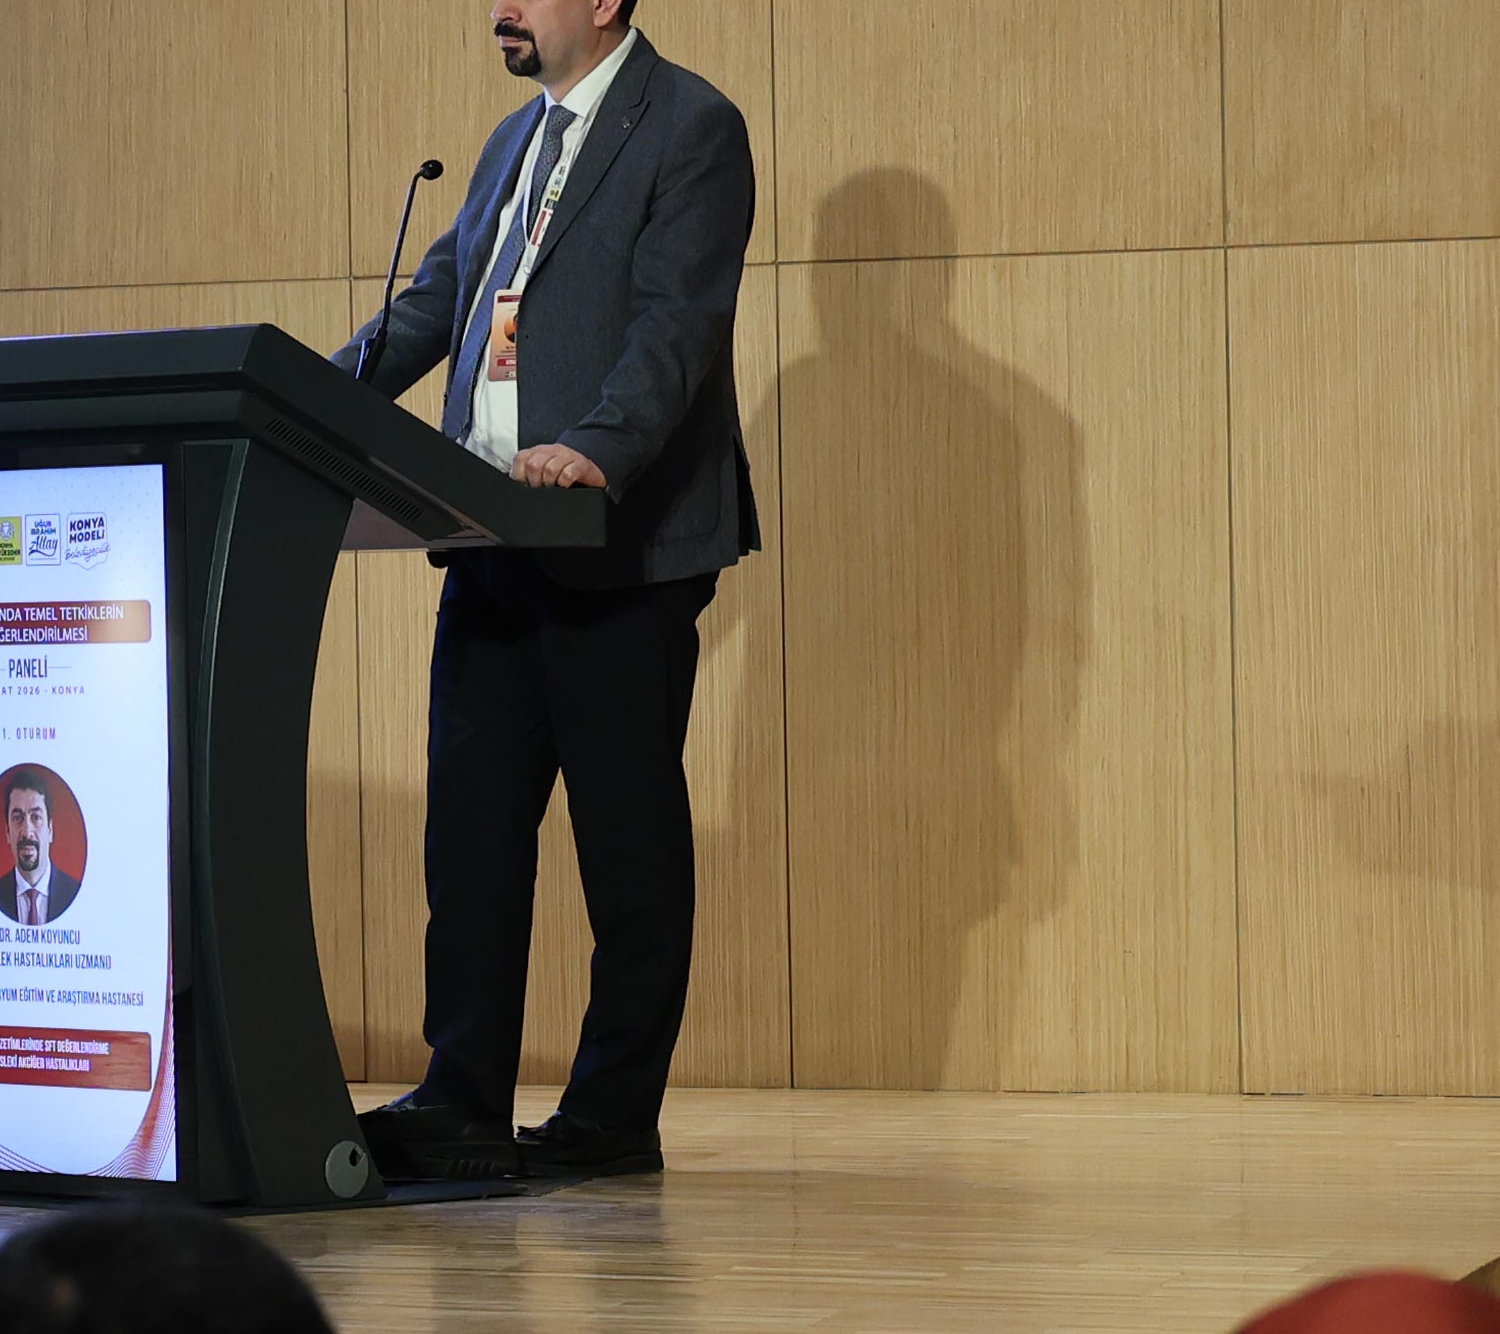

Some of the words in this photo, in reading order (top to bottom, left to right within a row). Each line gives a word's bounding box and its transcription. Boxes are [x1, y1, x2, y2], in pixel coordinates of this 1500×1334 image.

[69, 517, 105, 532] KONYA
[69, 529, 105, 544] MODELİ
[28, 535, 58, 557] Altay
[24, 608, 57, 621] TEMEL
[60, 604, 123, 620] TETKİKLERİN
[9, 655, 48, 678] PANELİ
[17, 687, 40, 695] 2026
[52, 686, 84, 695] KONYA
[2, 728, 11, 740] 1.
[16, 727, 56, 739] OTURUM
[0, 928, 13, 943] DR.
[15, 929, 39, 944] ADEM
[41, 929, 81, 945] KOYUNCU
[14, 952, 73, 968] HASTALIKLARI
[19, 986, 44, 1003] EĞİTİM
[45, 990, 55, 1003] VE
[57, 991, 100, 1007] ARAŞTIRMA
[102, 991, 144, 1006] HASTANESİ
